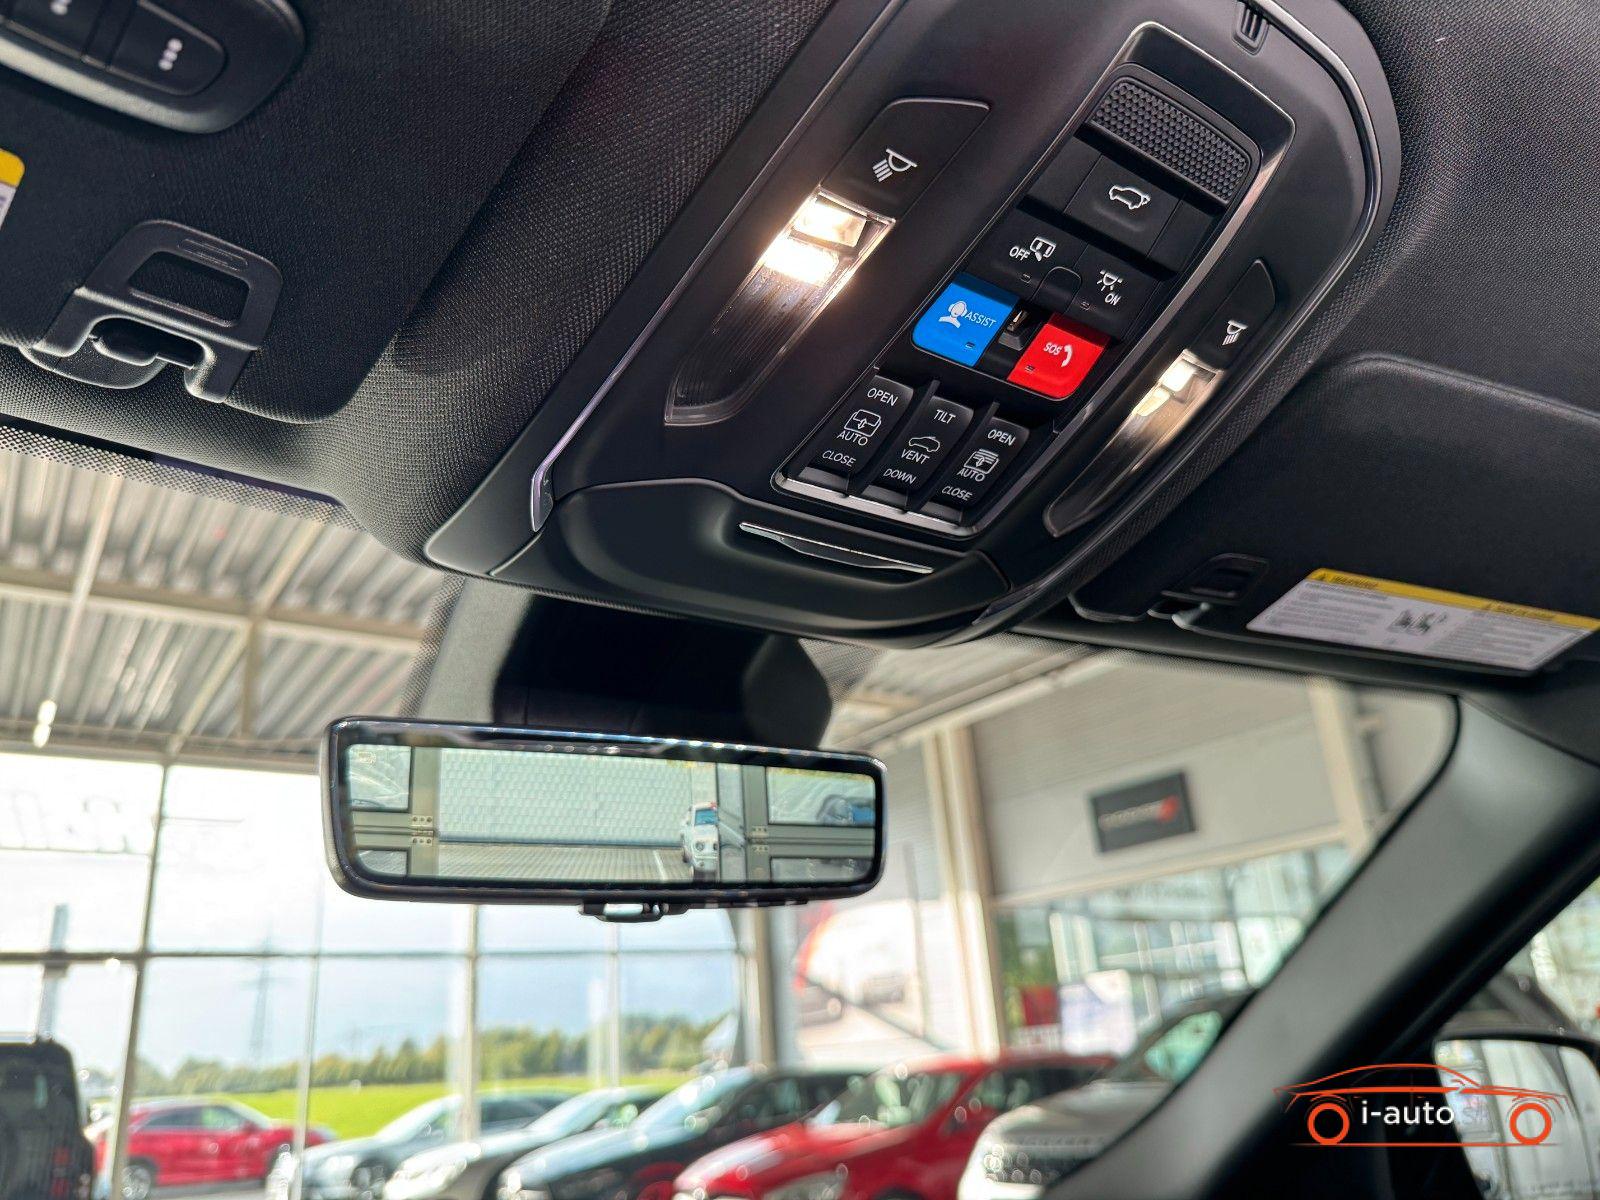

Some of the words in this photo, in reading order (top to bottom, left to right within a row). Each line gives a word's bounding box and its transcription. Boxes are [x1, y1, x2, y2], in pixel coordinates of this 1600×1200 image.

[1009, 245, 1031, 261] OFF
[1105, 292, 1122, 306] ON
[965, 310, 996, 328] ASSIST
[1043, 341, 1064, 356] SOS
[867, 387, 899, 407] OPEN
[934, 408, 957, 425] TILT
[836, 430, 869, 446] AUTO
[987, 429, 1017, 446] OPEN
[822, 450, 857, 468] CLOSE
[900, 449, 931, 466] VENT
[882, 468, 917, 485] DOWN
[956, 468, 986, 483] AUTO
[941, 485, 973, 502] CLOSE
